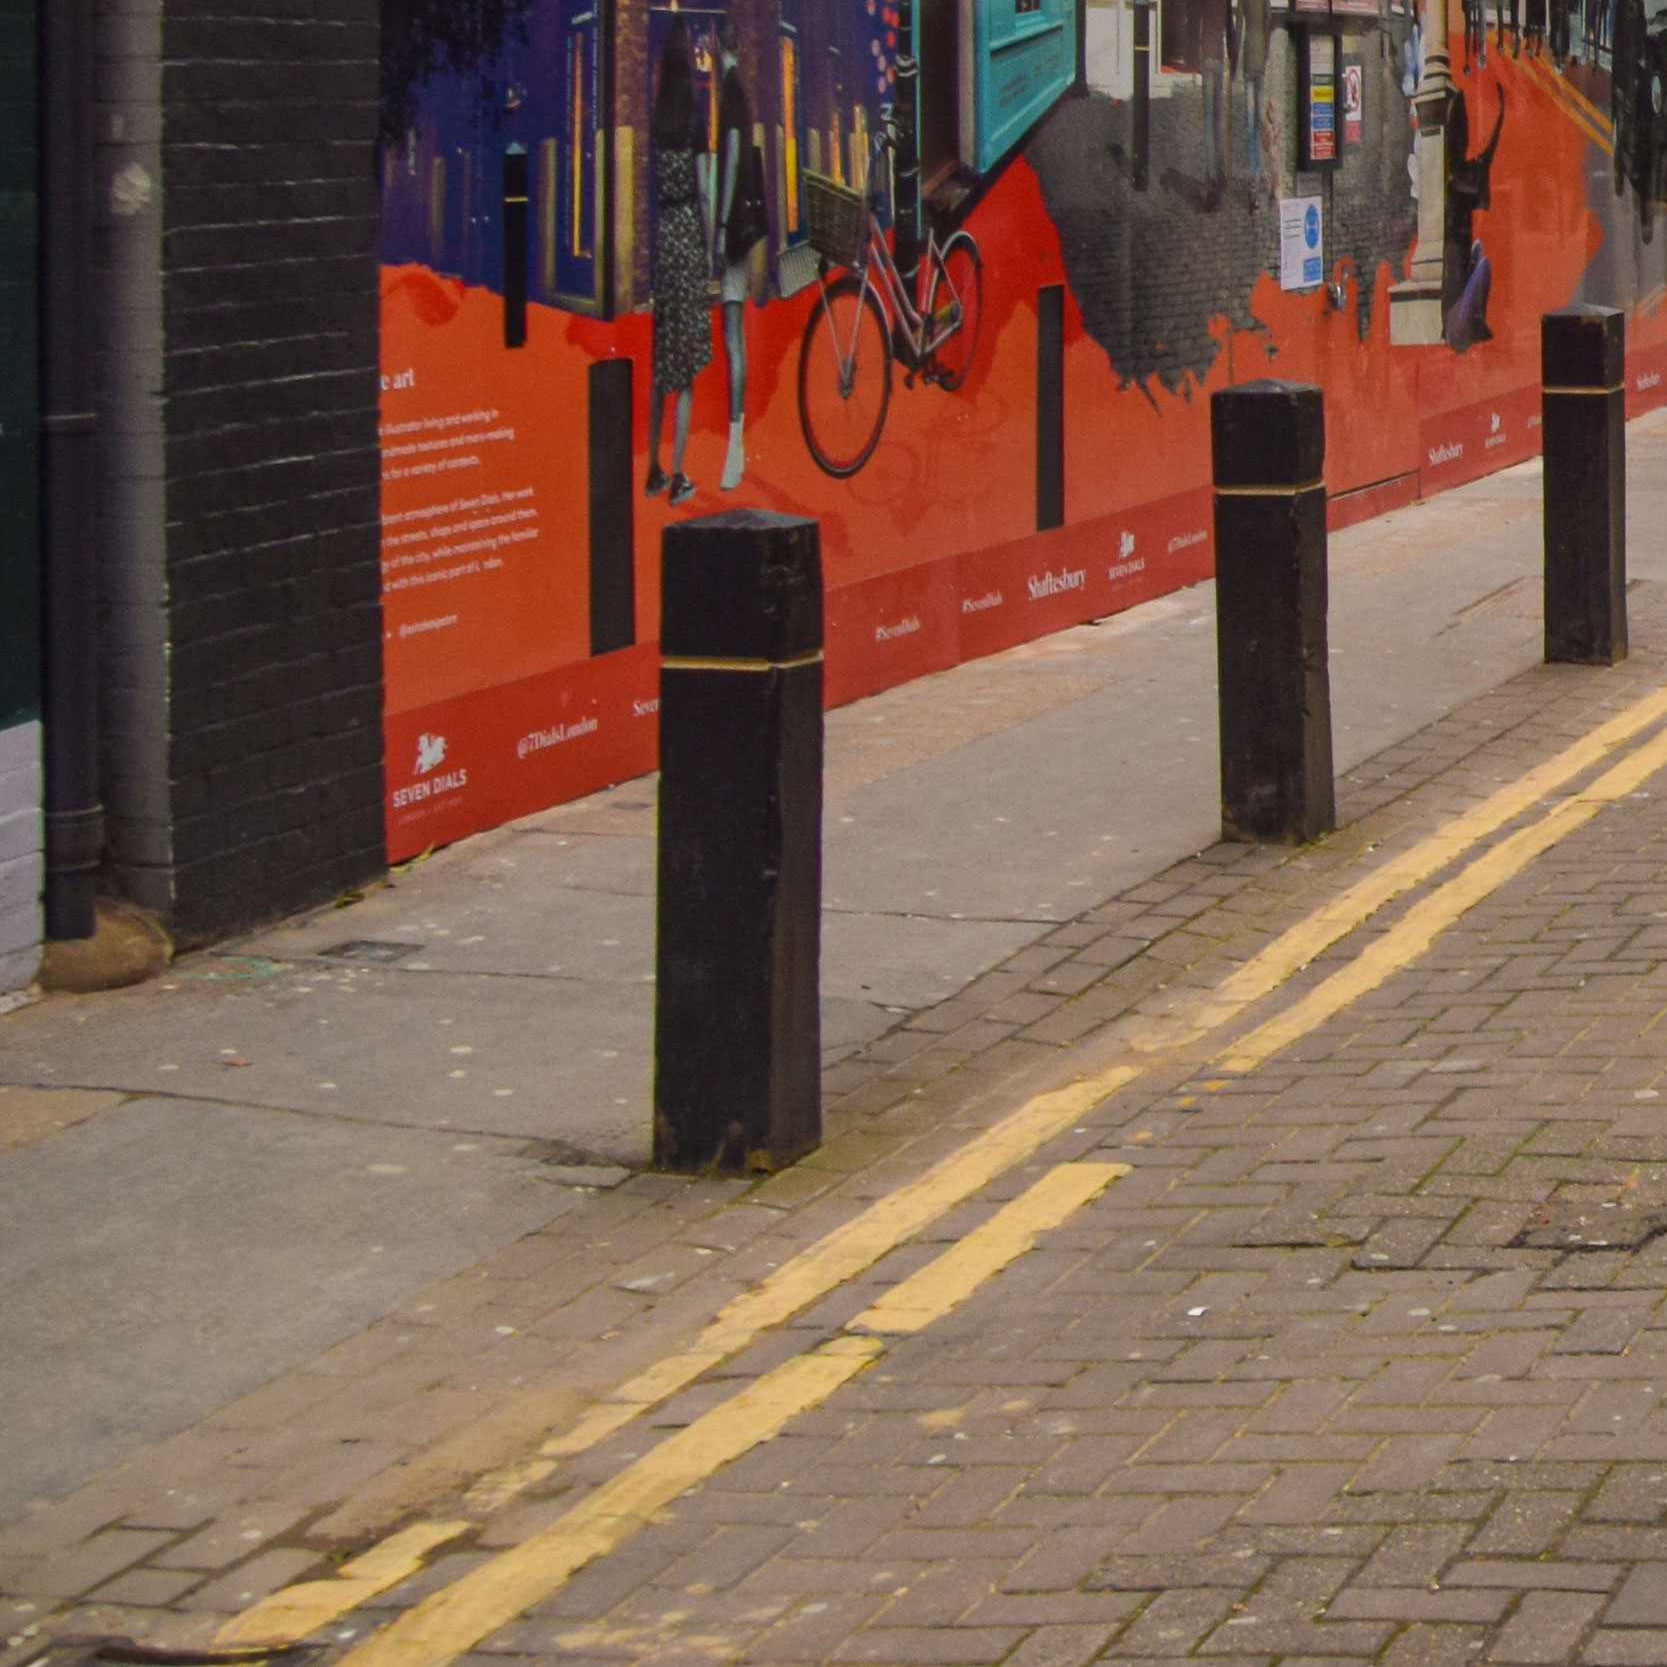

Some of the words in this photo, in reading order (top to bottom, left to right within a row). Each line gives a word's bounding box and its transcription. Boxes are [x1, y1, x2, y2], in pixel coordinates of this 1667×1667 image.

[392, 367, 415, 390] art
[1027, 567, 1087, 601] Shaftesbury
[516, 716, 599, 760] @7DialsLondon
[393, 780, 431, 808] SEVEN
[433, 768, 467, 794] DIALS
